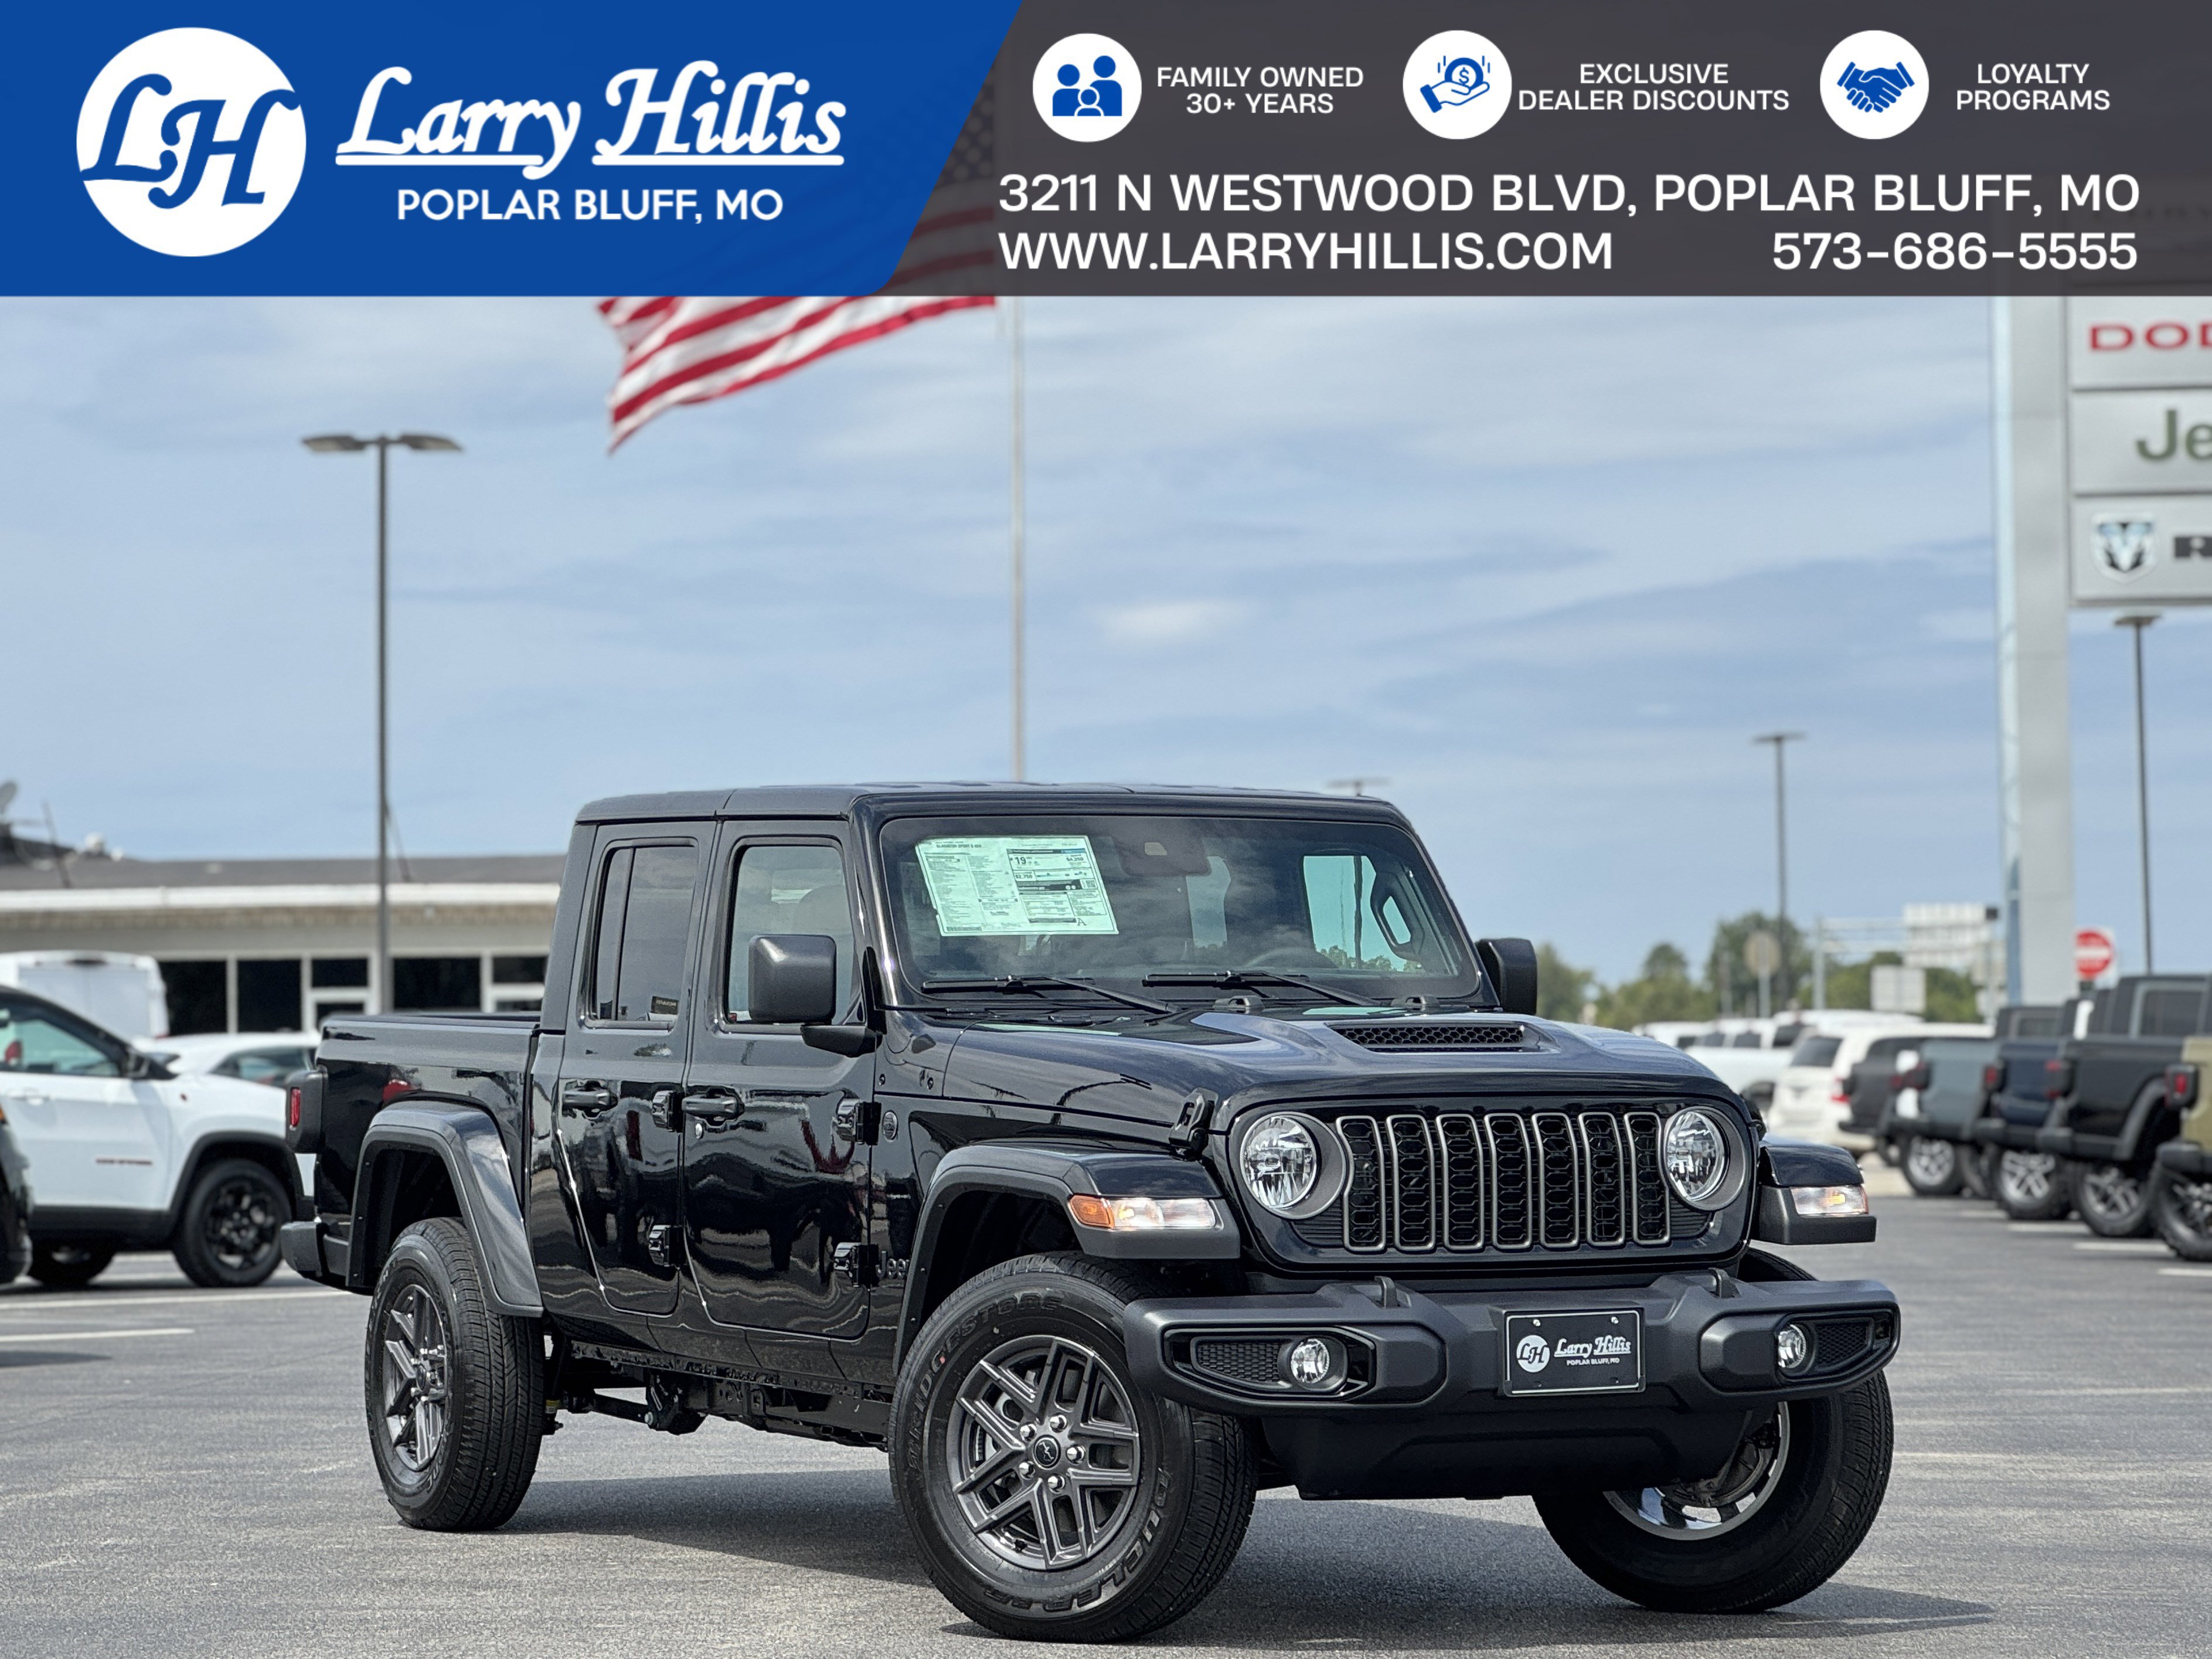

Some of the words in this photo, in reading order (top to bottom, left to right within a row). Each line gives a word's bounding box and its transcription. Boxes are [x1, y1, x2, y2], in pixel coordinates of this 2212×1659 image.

[2088, 322, 2212, 352] DO
[1554, 1338, 1592, 1358] Larry
[1594, 1335, 1631, 1355] Hillis
